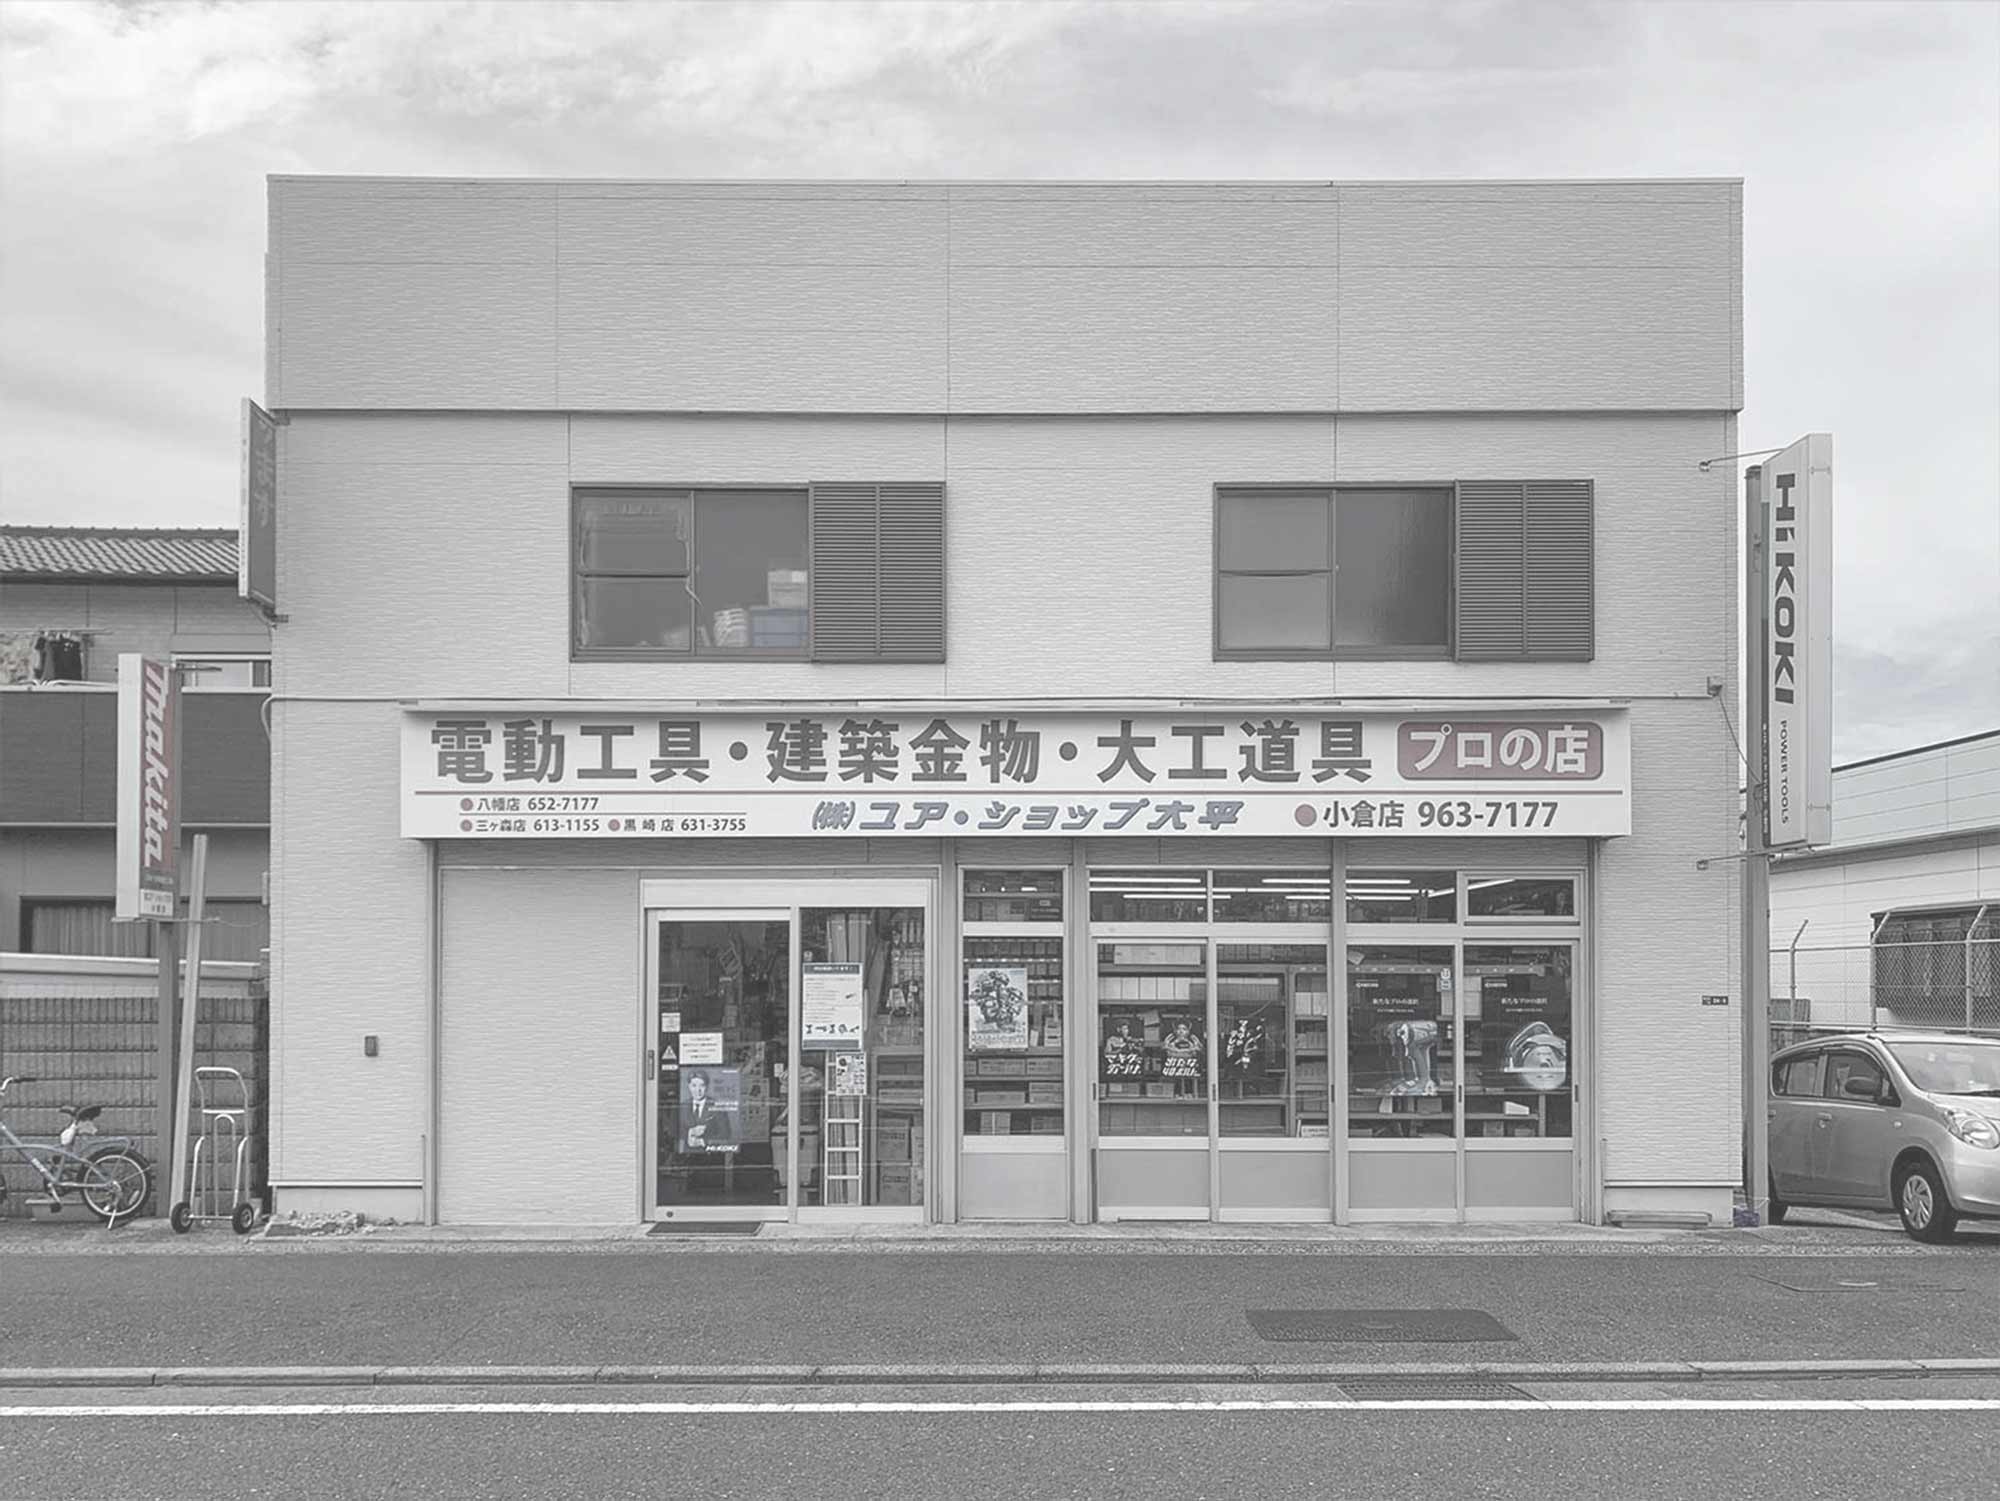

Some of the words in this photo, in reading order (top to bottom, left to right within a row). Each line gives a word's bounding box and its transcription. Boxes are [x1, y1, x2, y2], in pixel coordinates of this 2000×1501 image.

[1774, 473, 1796, 705] HiKOKI
[431, 719, 1372, 784] 電動工具・建築金物・大工道具
[1409, 723, 1590, 773] プロの店
[1779, 720, 1789, 774] POWER
[527, 797, 599, 811] 652-7177
[1323, 800, 1404, 828] 小倉店
[1417, 801, 1558, 828] 963-7177
[1780, 777, 1790, 824] TOOLS
[533, 819, 600, 832] 613-1155
[680, 818, 746, 832] 631-3755
